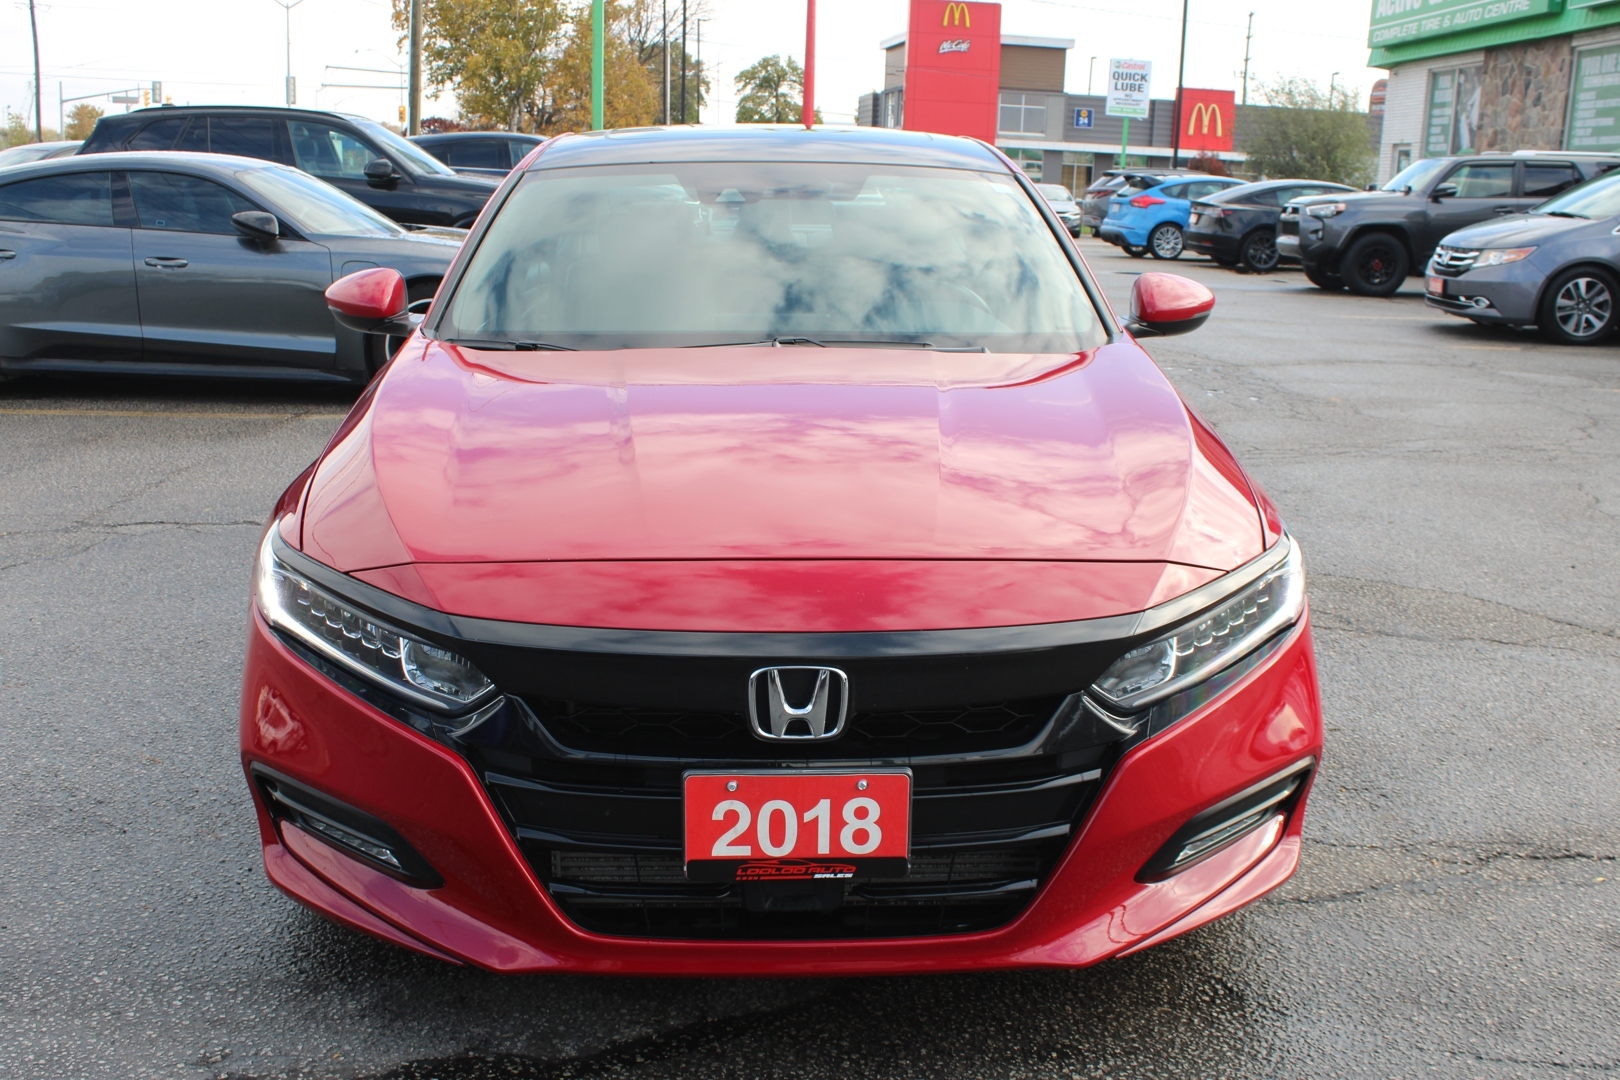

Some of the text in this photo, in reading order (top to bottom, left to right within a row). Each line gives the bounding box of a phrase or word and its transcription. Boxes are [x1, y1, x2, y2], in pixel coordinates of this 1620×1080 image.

[1373, 0, 1531, 42] COMPLETE TIRE & AUTO CENTRE
[1122, 62, 1146, 71] Castrol
[1112, 71, 1148, 82] QUICK
[1114, 82, 1144, 92] LUBE
[711, 797, 882, 857] 2018
[736, 866, 857, 875] LOOLOO AUTO
